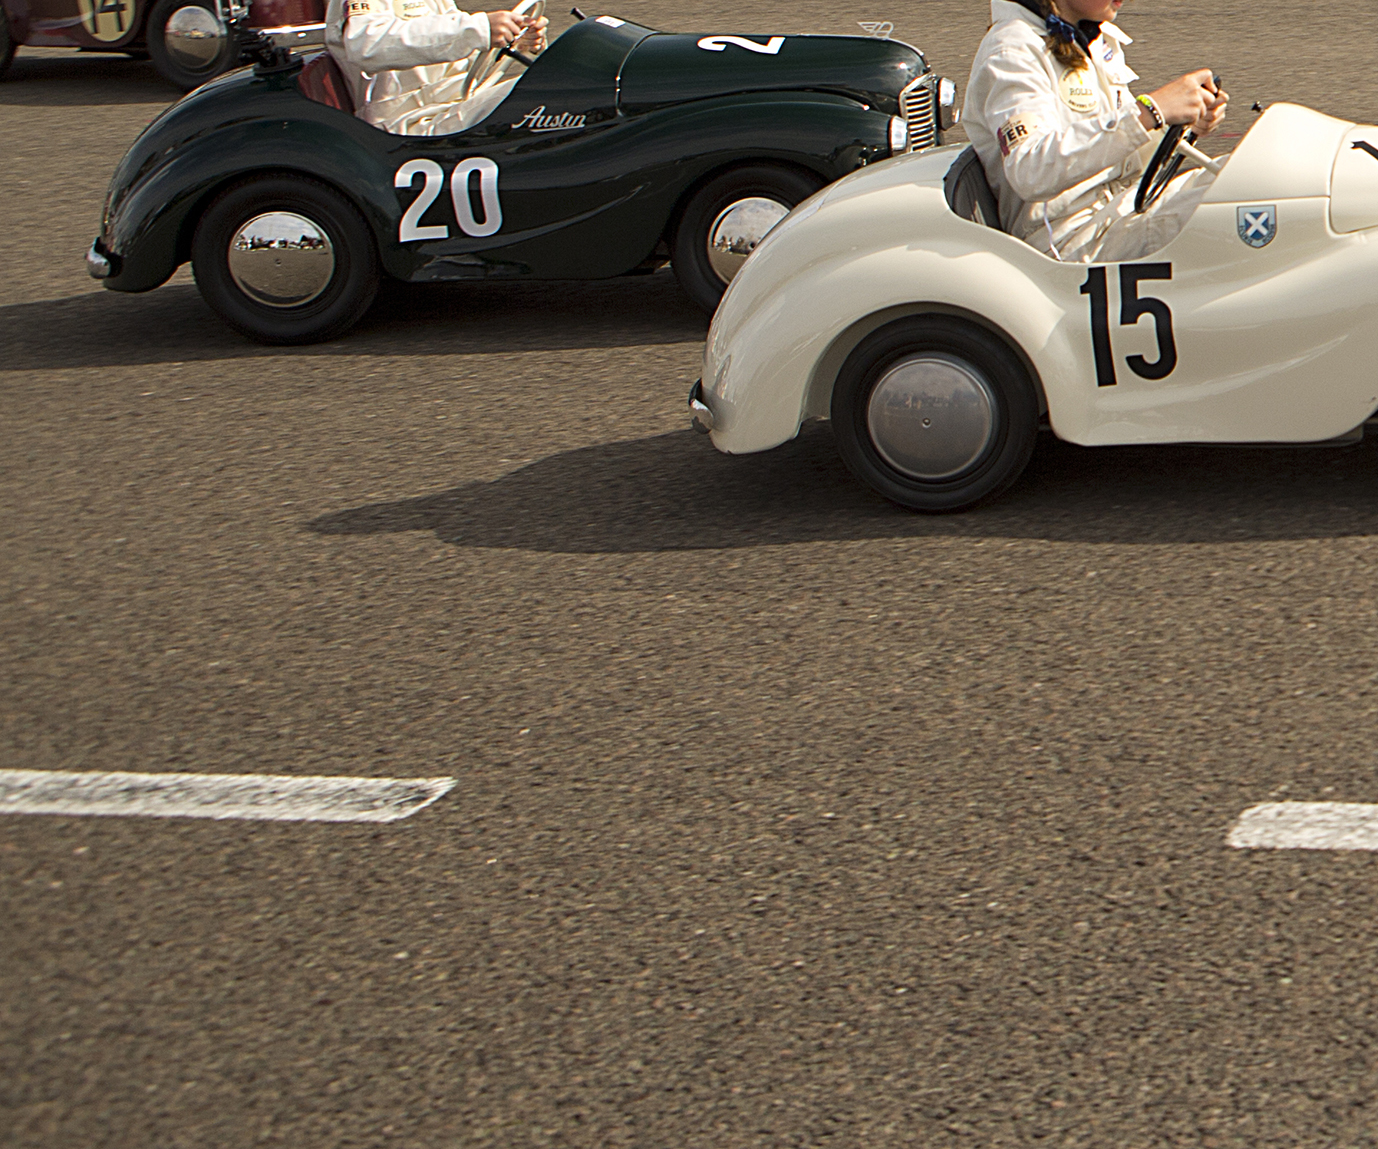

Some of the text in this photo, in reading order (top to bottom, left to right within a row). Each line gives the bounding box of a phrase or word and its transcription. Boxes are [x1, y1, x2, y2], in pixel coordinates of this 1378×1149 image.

[511, 105, 587, 132] Austin
[394, 156, 503, 243] 20
[1079, 262, 1178, 388] 15
